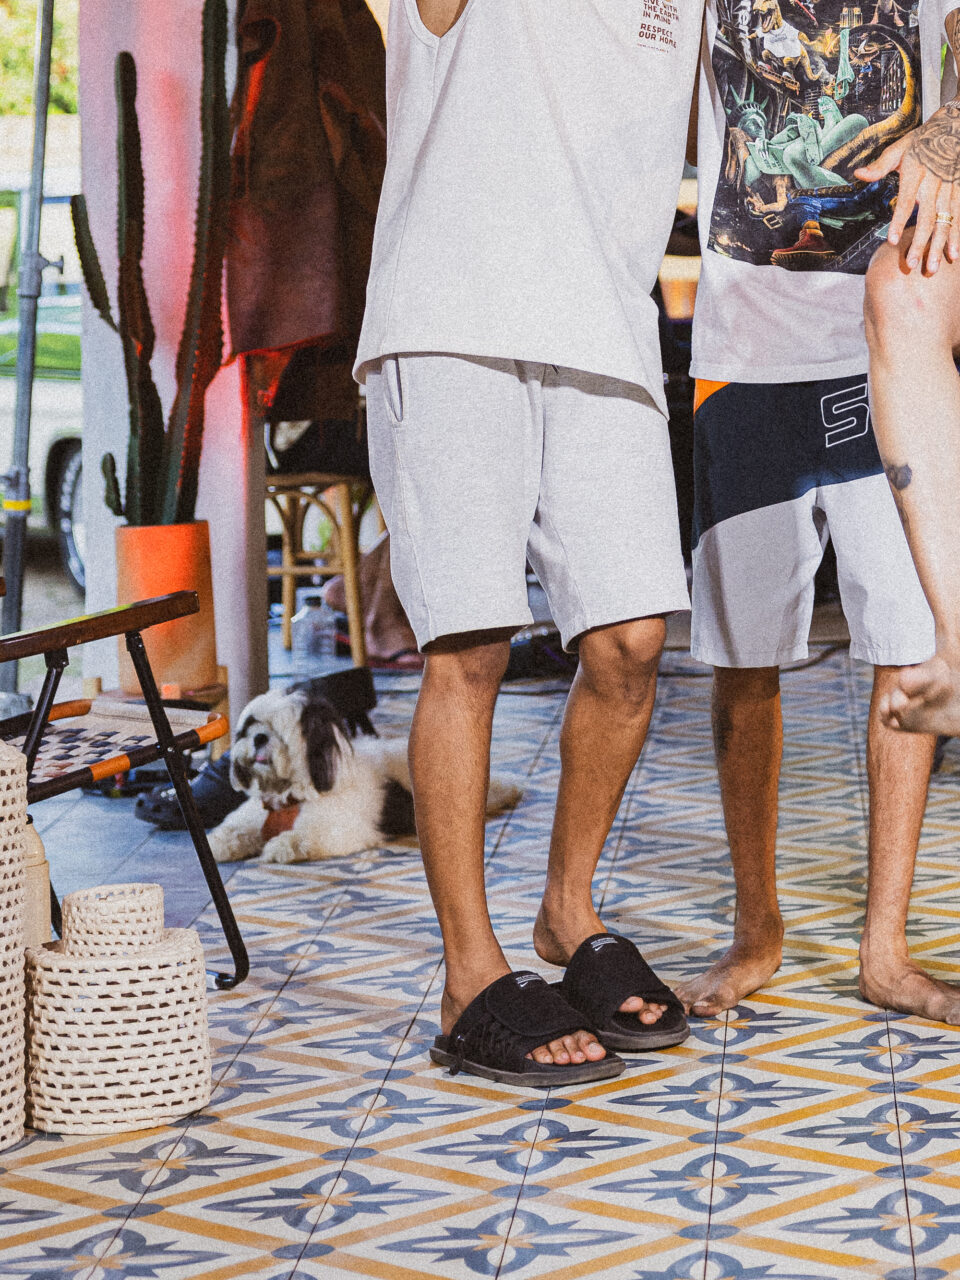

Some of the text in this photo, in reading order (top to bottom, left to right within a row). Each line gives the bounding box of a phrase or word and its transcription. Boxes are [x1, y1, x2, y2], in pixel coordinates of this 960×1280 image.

[643, 3, 679, 22] THE EARTH
[662, 1, 678, 13] WITH
[653, 13, 671, 25] MIND
[640, 23, 673, 38] RESPECT
[638, 31, 657, 41] OUR
[659, 36, 677, 49] HOME
